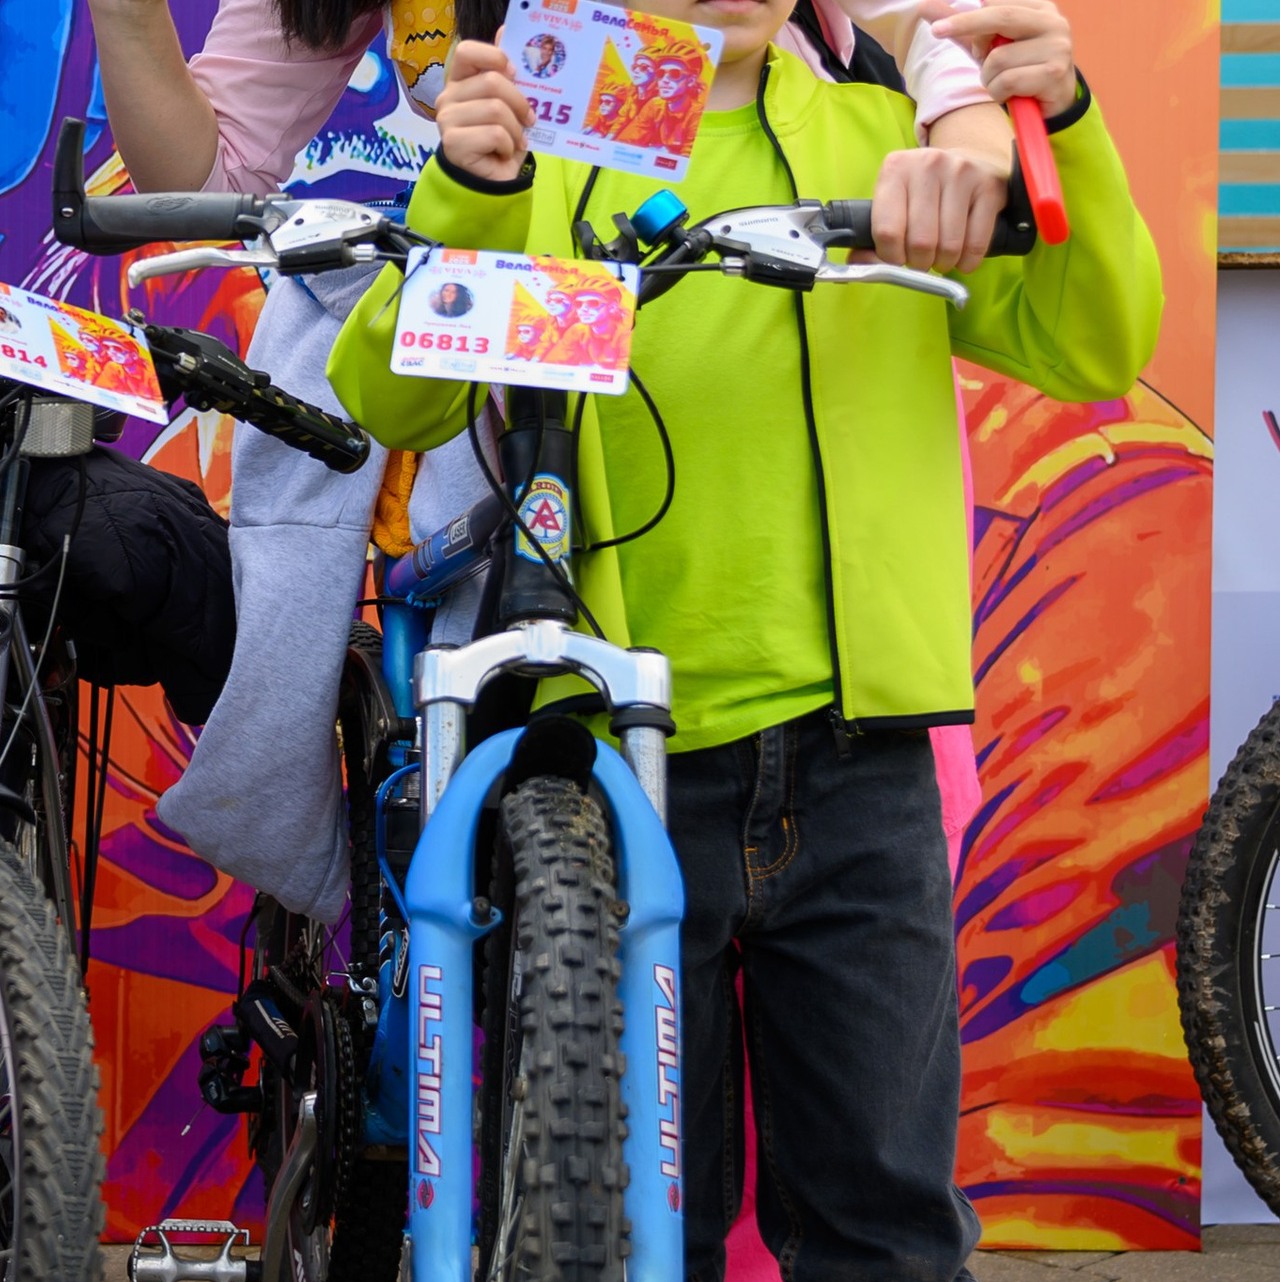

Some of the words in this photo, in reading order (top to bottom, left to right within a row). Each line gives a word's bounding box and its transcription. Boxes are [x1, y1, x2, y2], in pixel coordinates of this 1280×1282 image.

[399, 330, 490, 354] 06813
[417, 963, 442, 1178] ULTIMA
[652, 962, 681, 1180] ULTIMA
